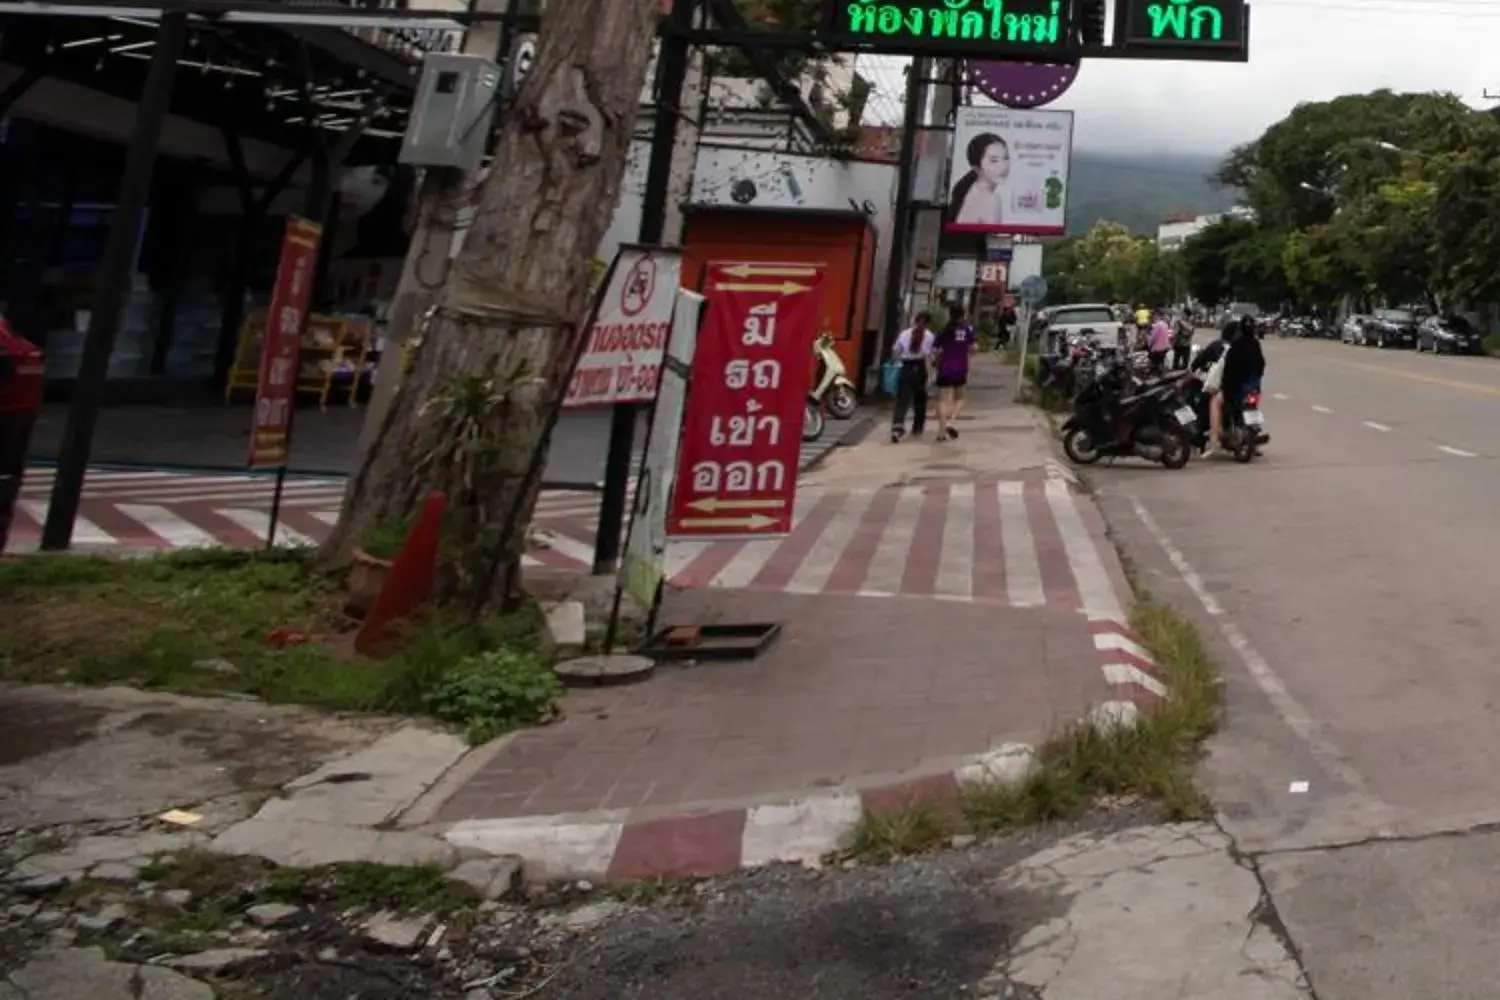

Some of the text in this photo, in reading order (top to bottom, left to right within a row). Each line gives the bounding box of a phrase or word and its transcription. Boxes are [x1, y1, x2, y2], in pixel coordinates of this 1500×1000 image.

[741, 301, 779, 346] มี
[724, 359, 781, 389] รถ
[709, 399, 780, 446] เข้า
[692, 459, 785, 492] ออก
